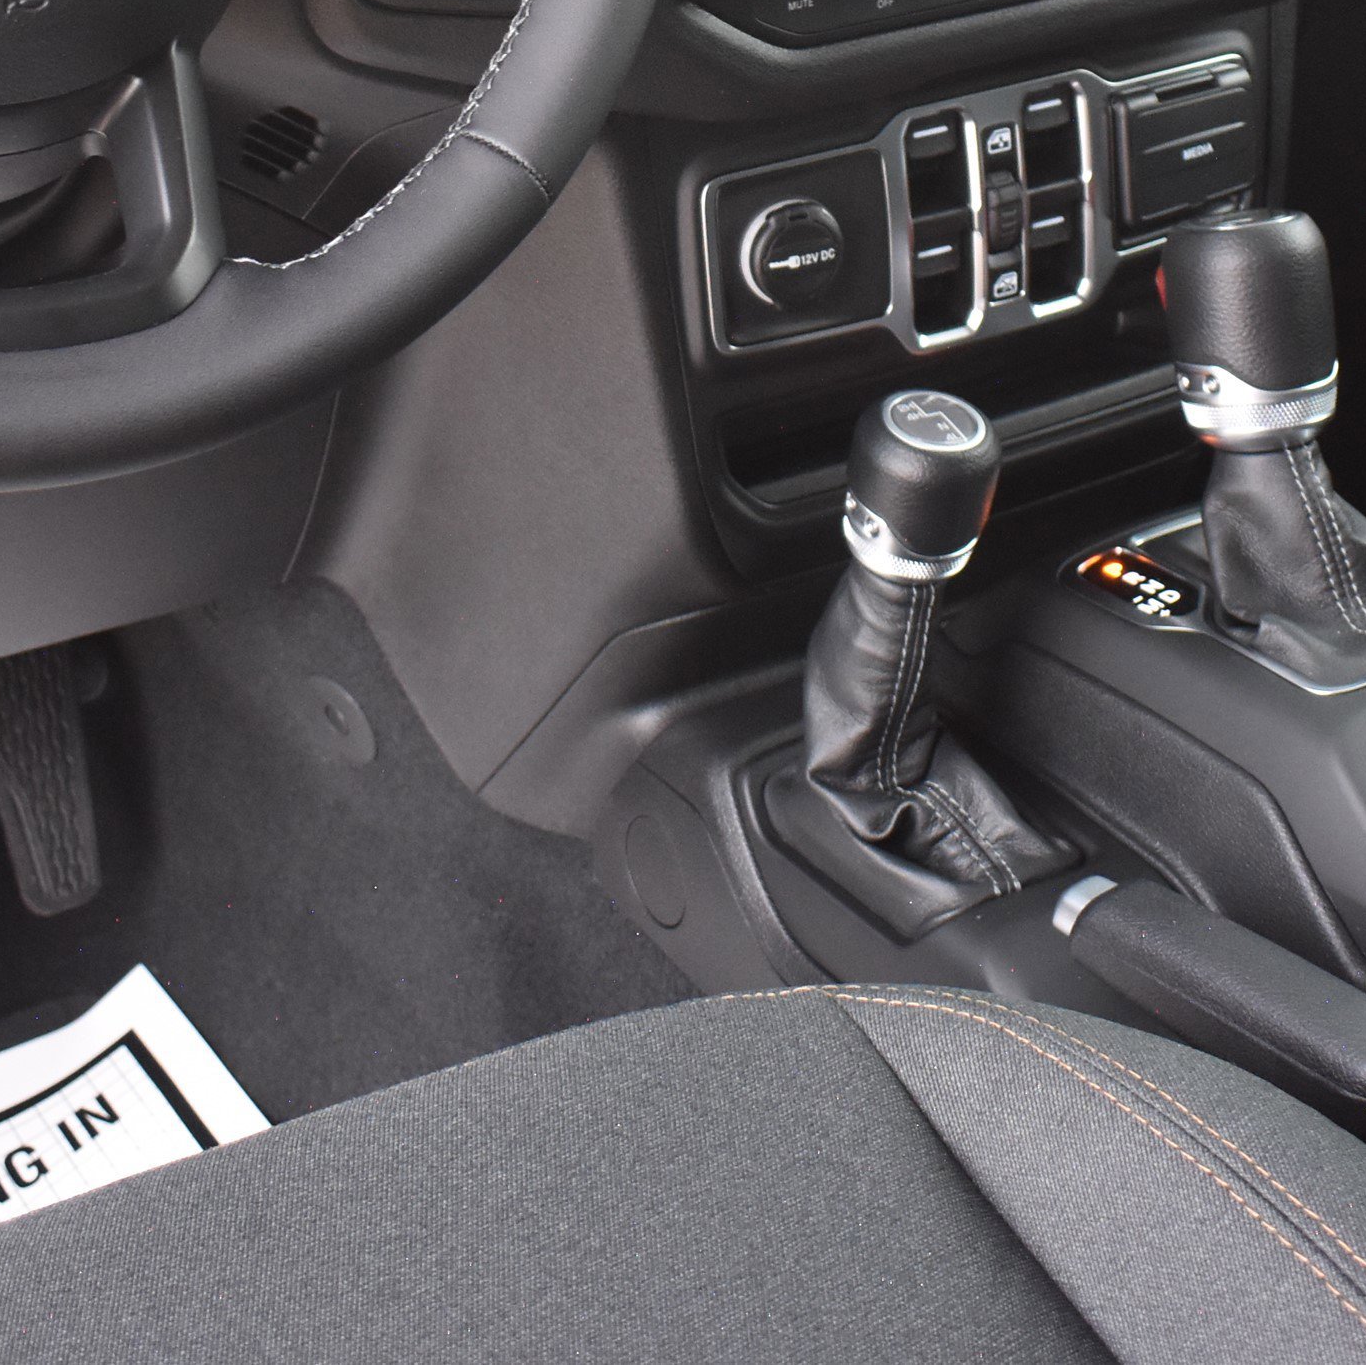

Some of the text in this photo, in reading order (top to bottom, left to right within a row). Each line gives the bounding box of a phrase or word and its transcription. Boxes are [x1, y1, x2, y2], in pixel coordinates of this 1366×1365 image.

[1182, 143, 1213, 161] MEDIA
[800, 247, 836, 266] 12V DC
[1139, 578, 1165, 595] N
[1158, 589, 1181, 604] D
[57, 1093, 119, 1152] IN
